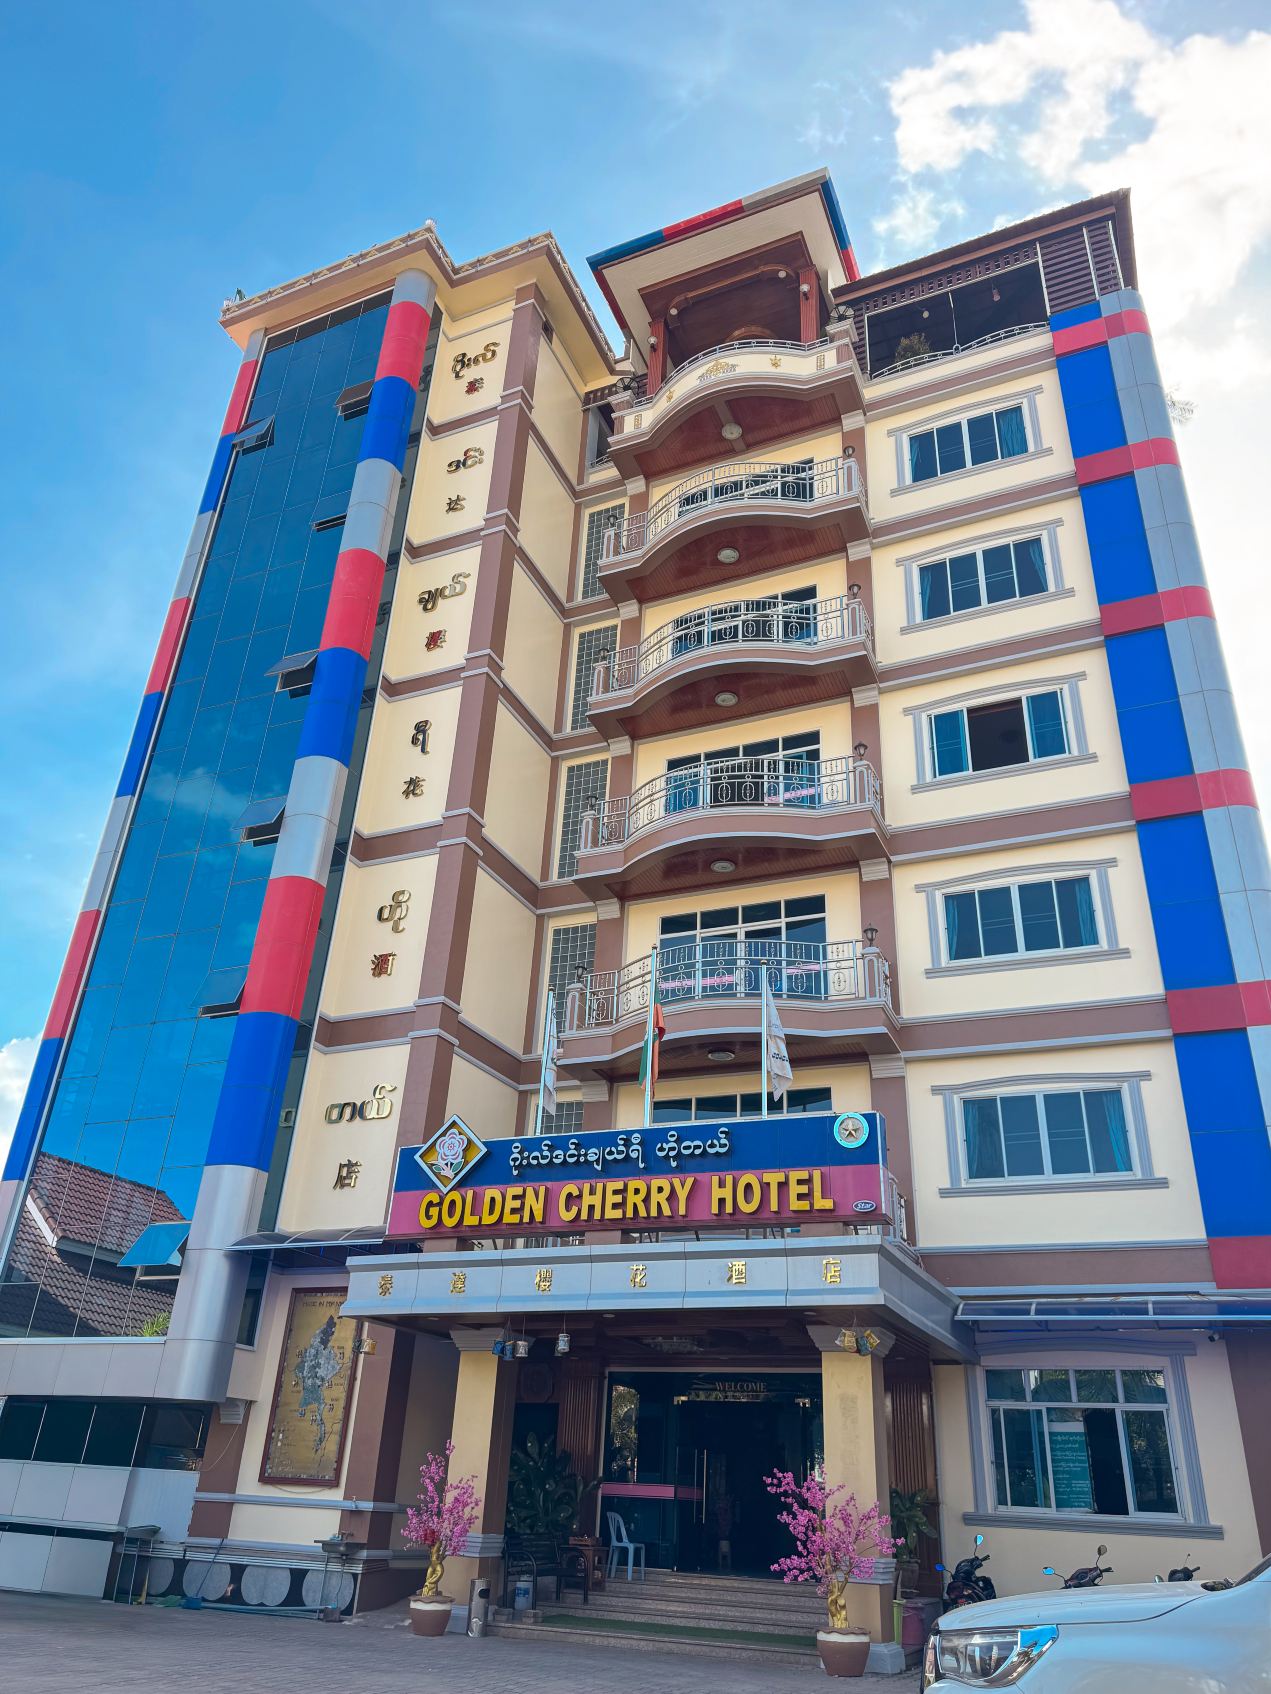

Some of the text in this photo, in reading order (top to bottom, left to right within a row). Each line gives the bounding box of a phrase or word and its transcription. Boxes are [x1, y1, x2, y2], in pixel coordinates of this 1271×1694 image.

[332, 1158, 362, 1191] 店
[418, 1169, 834, 1229] GOLDEN CHERRY HOTEL
[715, 1382, 767, 1391] WELCOME
